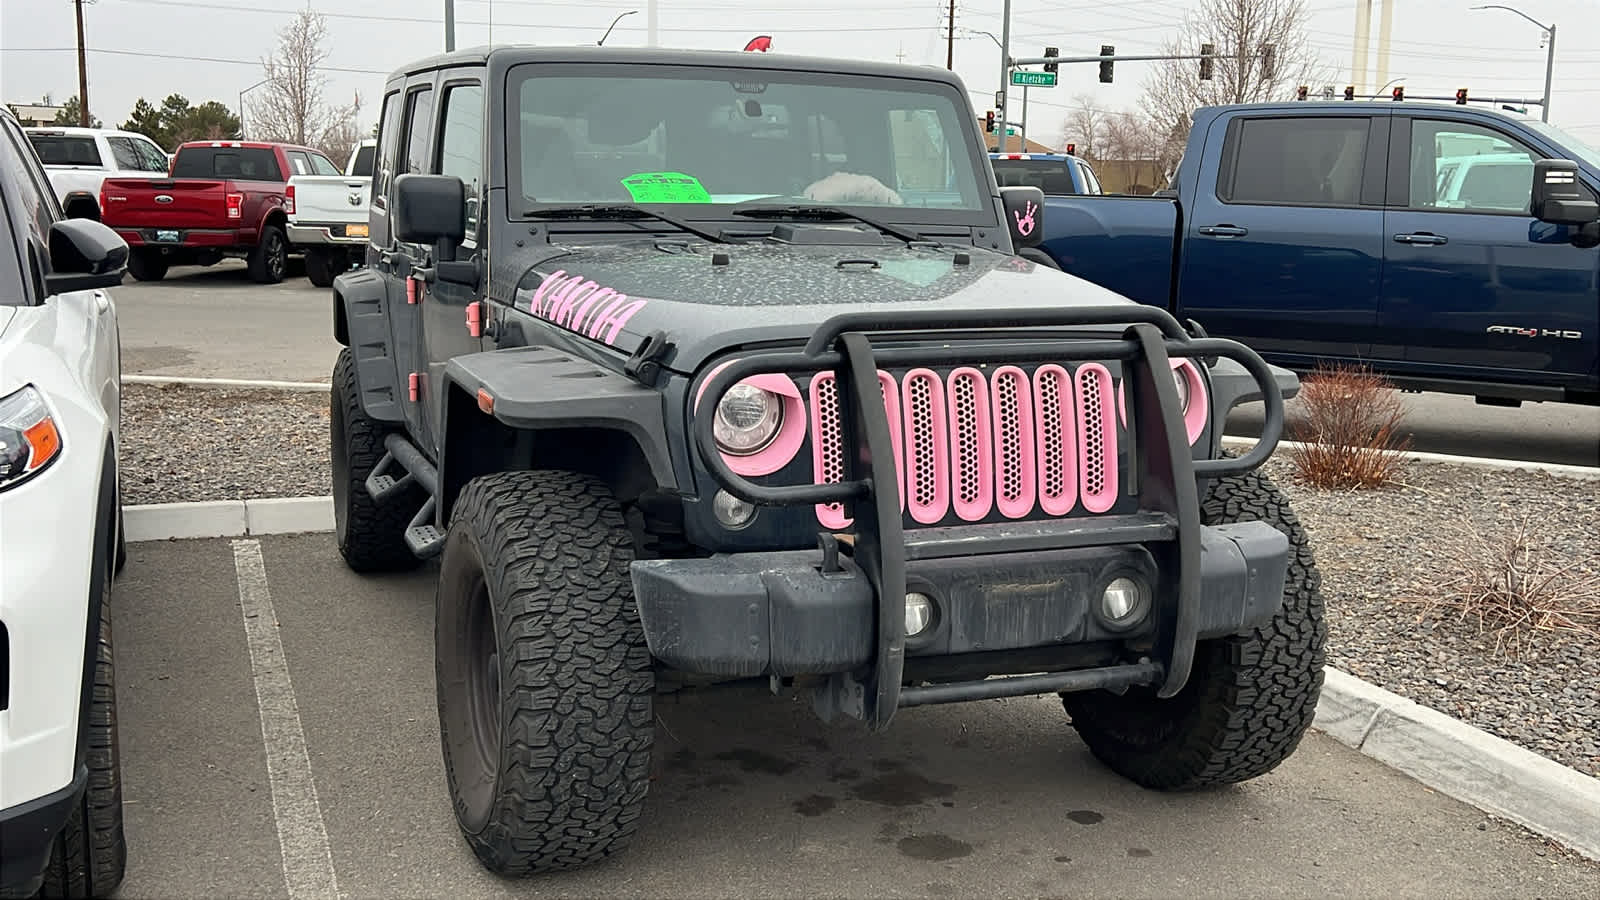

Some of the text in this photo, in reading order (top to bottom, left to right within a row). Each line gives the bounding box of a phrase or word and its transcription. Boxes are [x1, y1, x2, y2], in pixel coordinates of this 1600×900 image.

[531, 270, 648, 345] KARMA
[1486, 325, 1582, 338] AT4 HD
